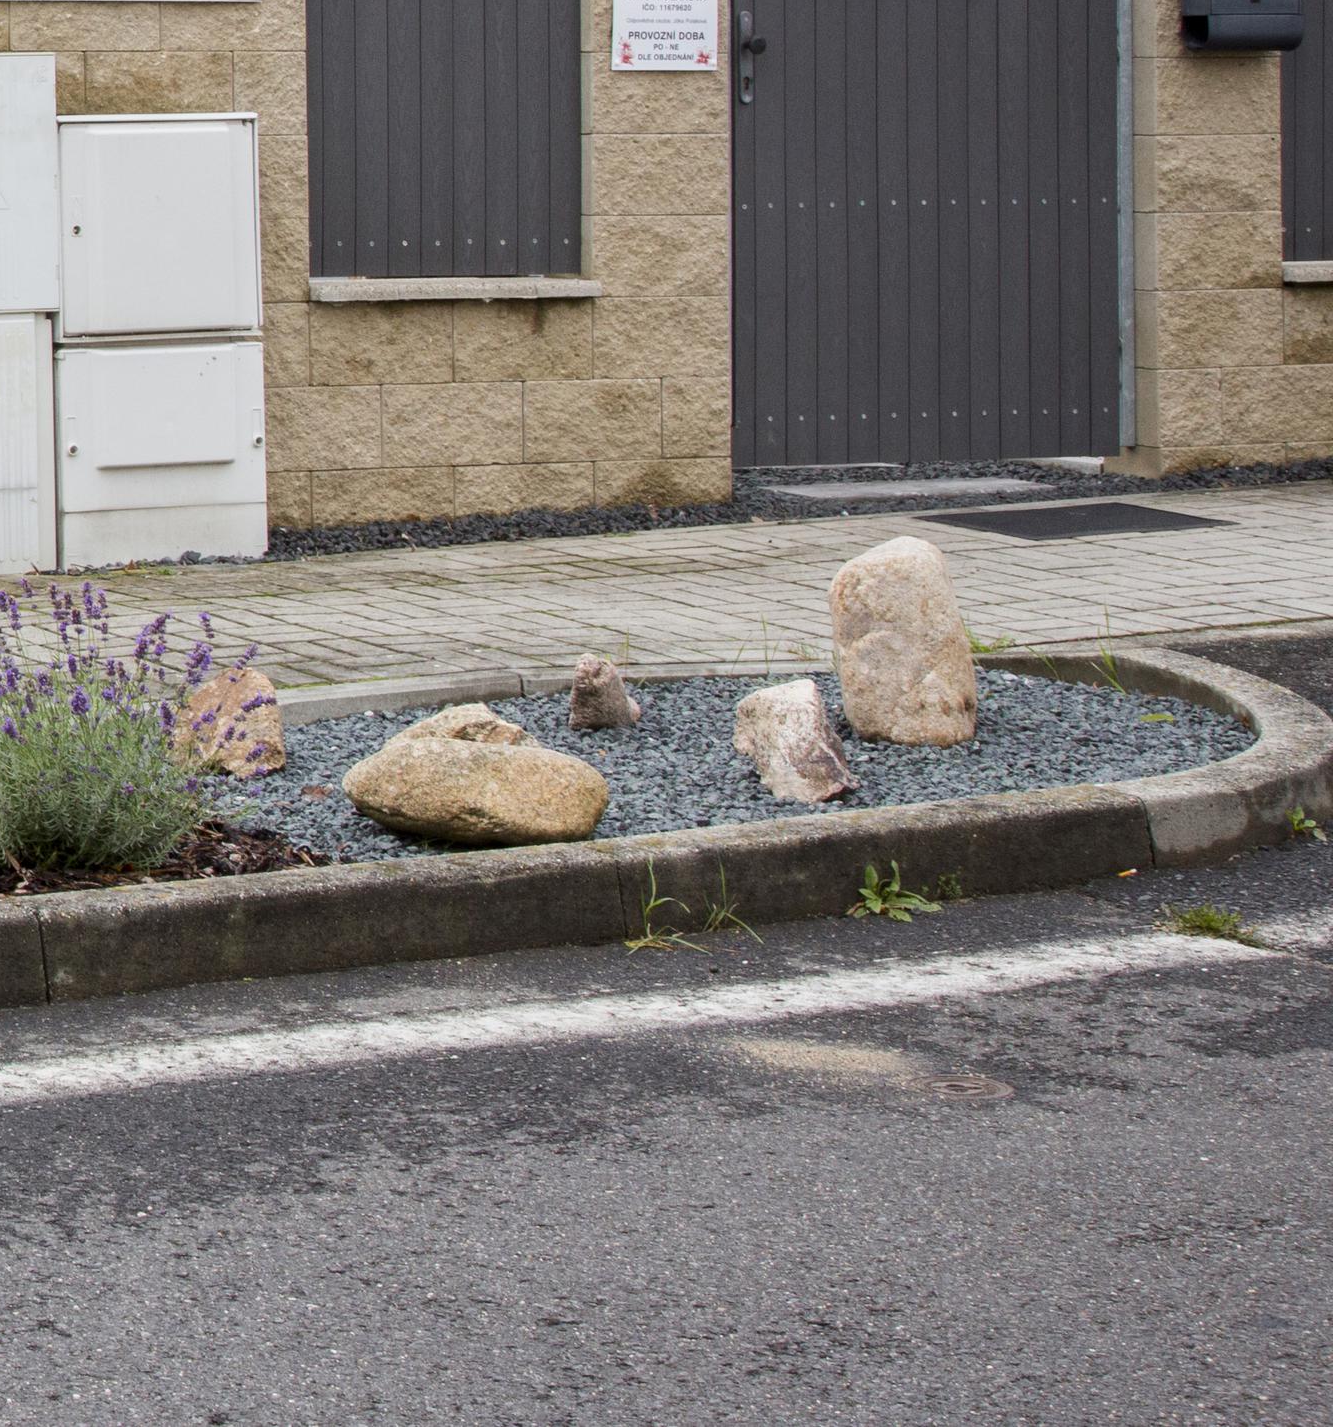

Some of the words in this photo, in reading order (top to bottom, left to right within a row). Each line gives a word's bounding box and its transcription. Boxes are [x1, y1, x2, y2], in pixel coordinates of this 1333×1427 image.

[628, 30, 675, 40] PROVOZNÍ
[678, 31, 705, 40] DOBA
[653, 52, 694, 61] OBJEDNÁNÍ
